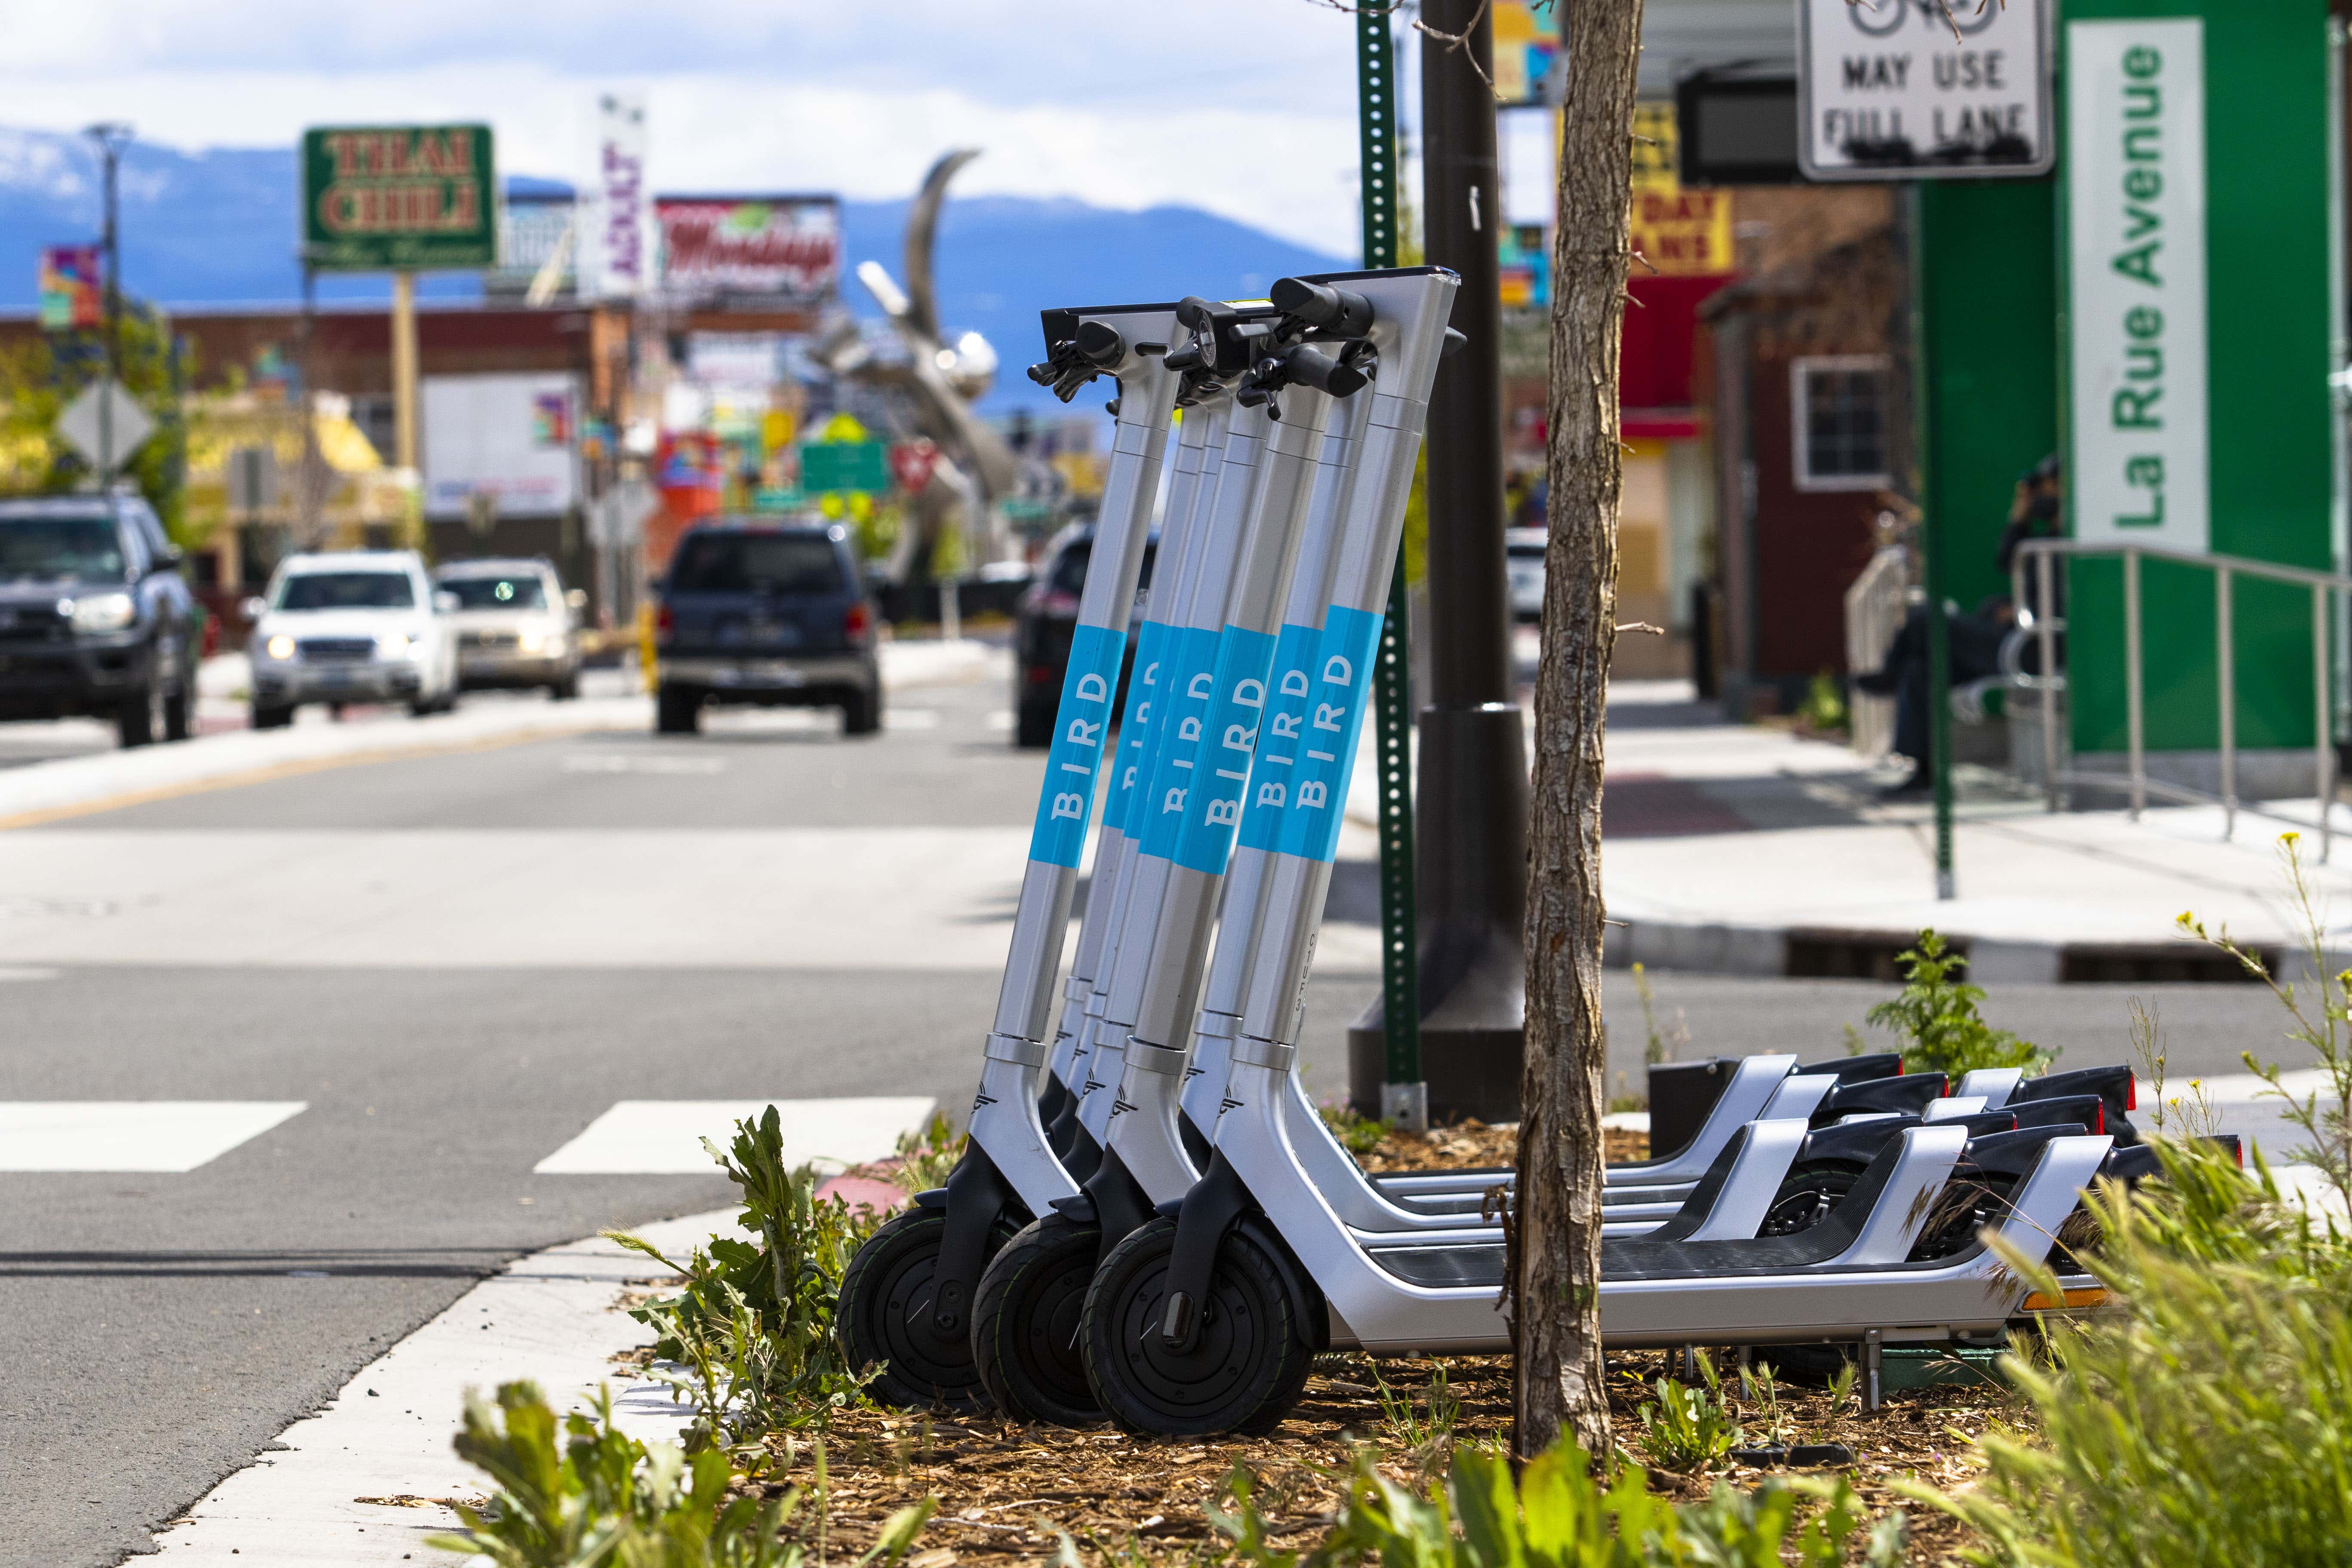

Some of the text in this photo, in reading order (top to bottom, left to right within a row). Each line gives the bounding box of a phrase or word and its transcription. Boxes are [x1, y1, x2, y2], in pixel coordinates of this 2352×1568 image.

[1842, 50, 2007, 90] MAY USE
[325, 130, 472, 177] THAI
[1824, 103, 2026, 149] FULL LANE
[320, 184, 481, 232] CHILI
[2111, 45, 2164, 528] La Rue Avenue
[1051, 674, 1107, 820] BIRD
[1205, 678, 1265, 826] BIRD
[1257, 670, 1309, 808] BIRD
[1297, 656, 1352, 809] BIRD
[1296, 933, 1315, 1011] C1UF3
